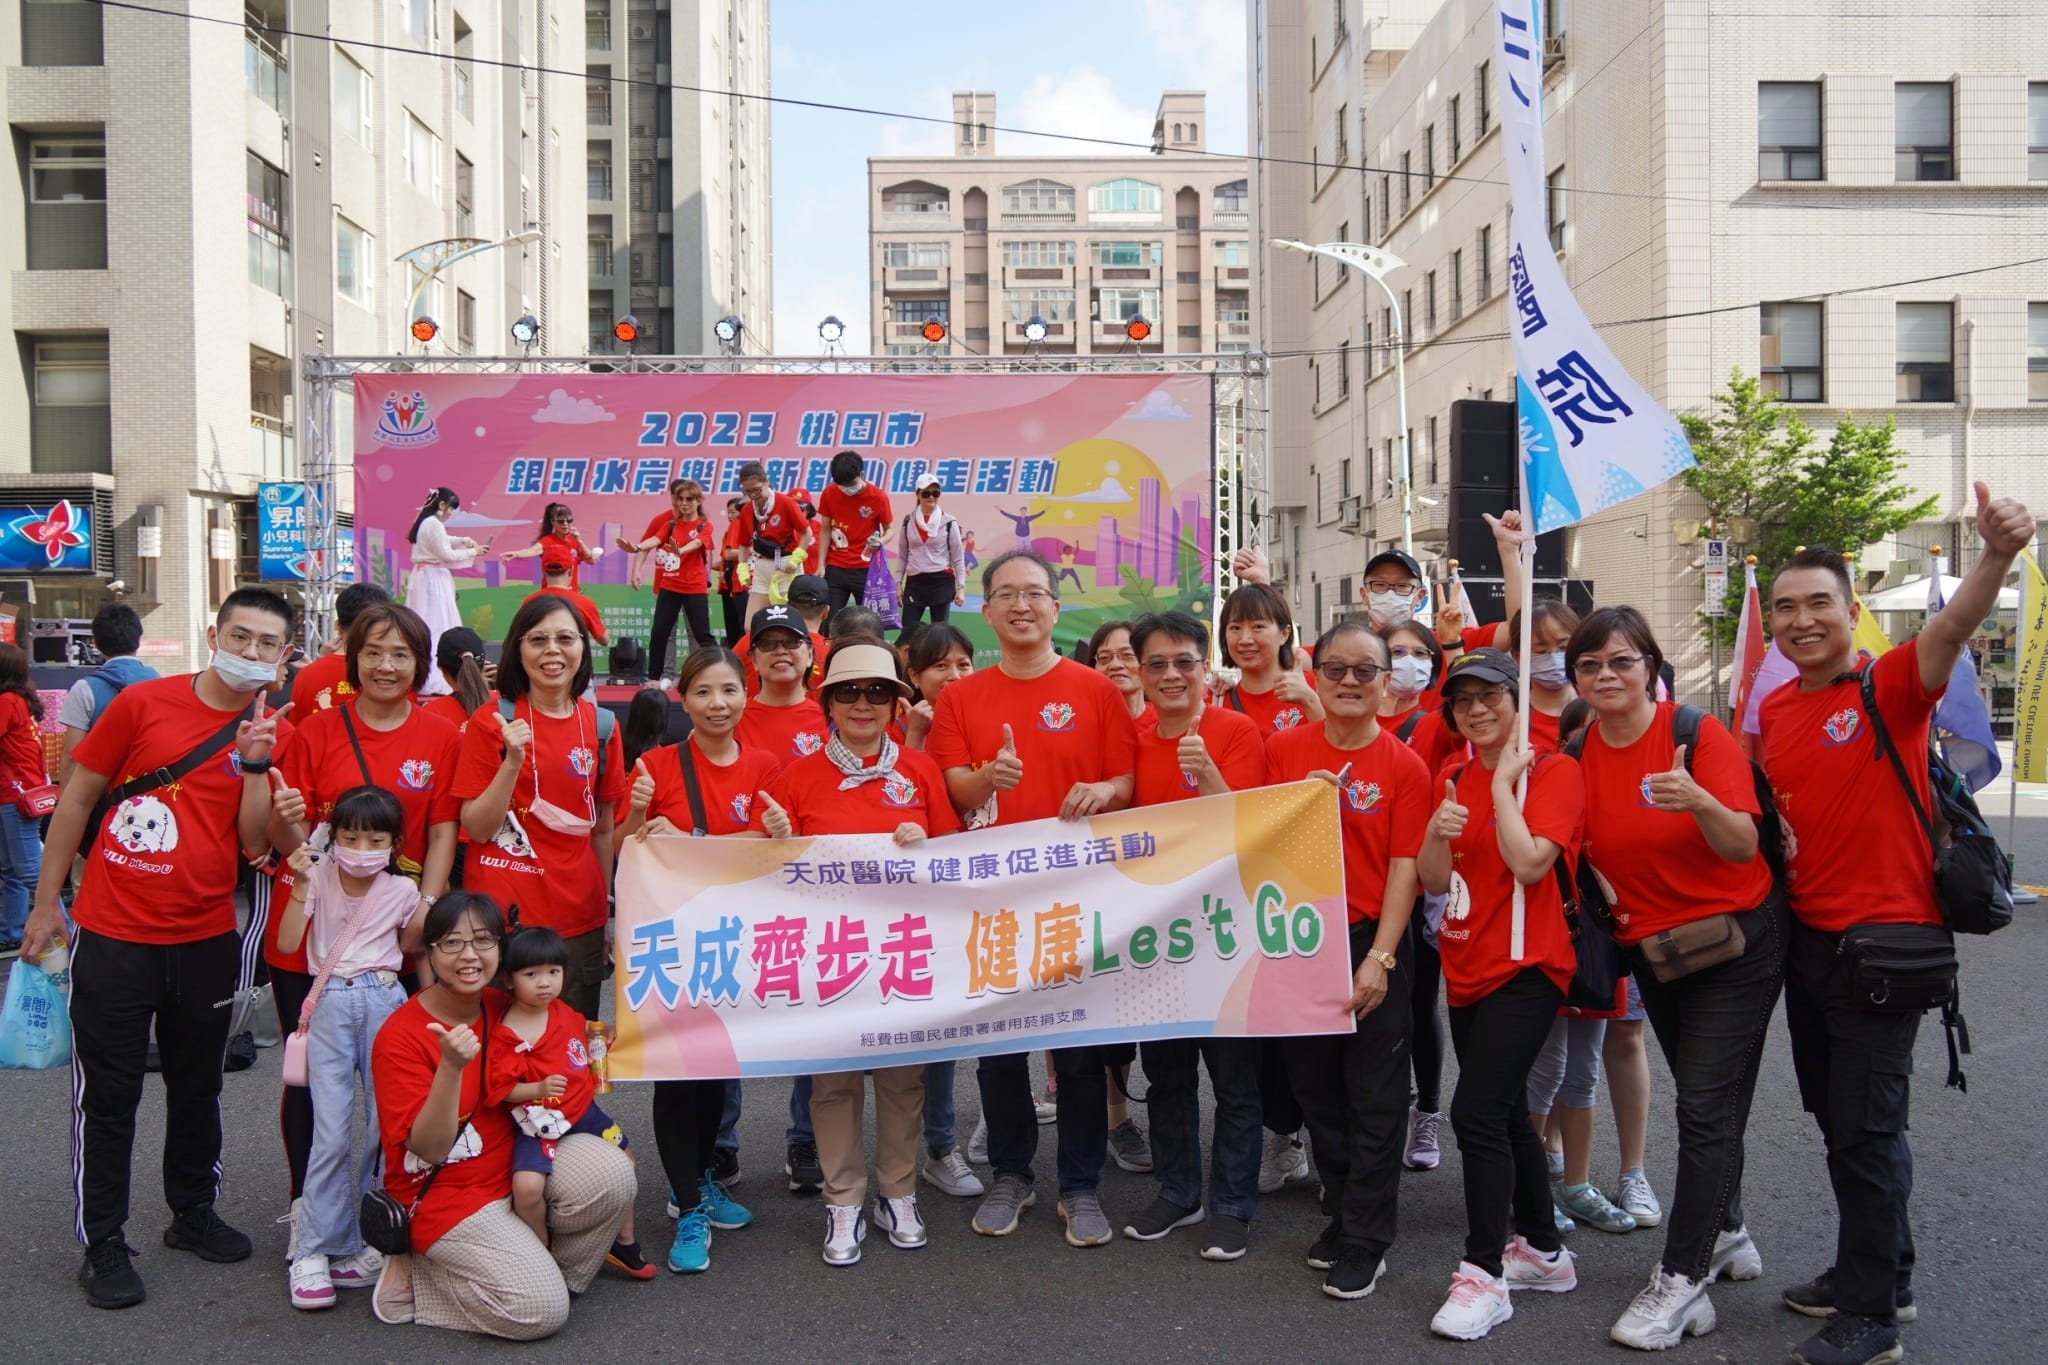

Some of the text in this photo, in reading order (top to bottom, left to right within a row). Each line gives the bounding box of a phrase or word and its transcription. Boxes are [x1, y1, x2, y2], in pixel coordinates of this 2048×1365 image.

[638, 411, 925, 448] 2023 桃園市
[783, 831, 1157, 885] 天成醫院 健康促進活動
[626, 911, 937, 1010] 天成齊步走
[1255, 882, 1322, 956] Go
[859, 1007, 1087, 1047] 經費由國民健康署運用菸捐支應
